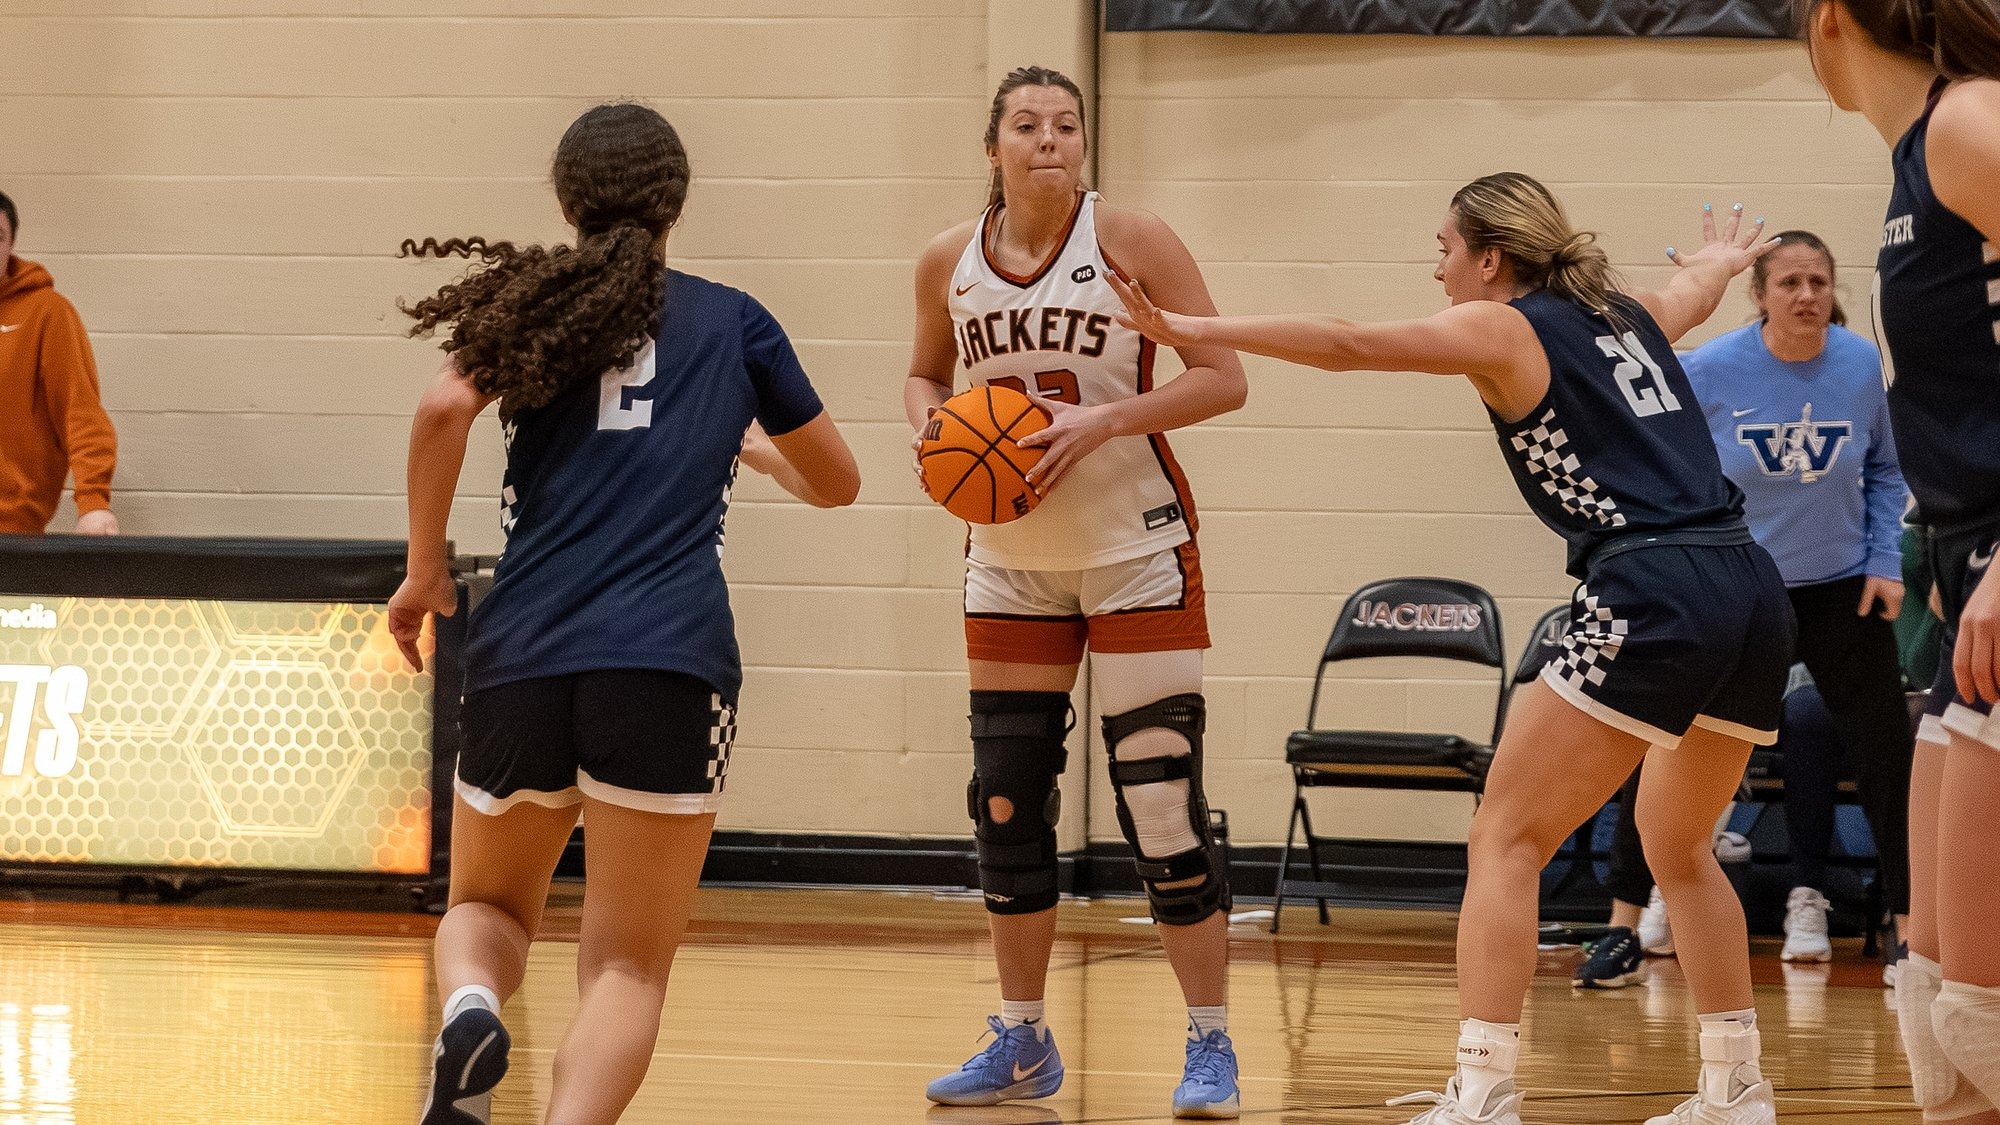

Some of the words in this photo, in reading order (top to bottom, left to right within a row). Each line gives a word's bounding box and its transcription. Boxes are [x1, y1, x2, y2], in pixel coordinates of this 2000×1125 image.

[959, 306, 1112, 370] JACKETS
[1595, 331, 1682, 418] 21
[597, 331, 656, 431] 2
[1737, 421, 1852, 476] W
[1352, 600, 1483, 632] JACKETS
[0, 664, 89, 778] TS
